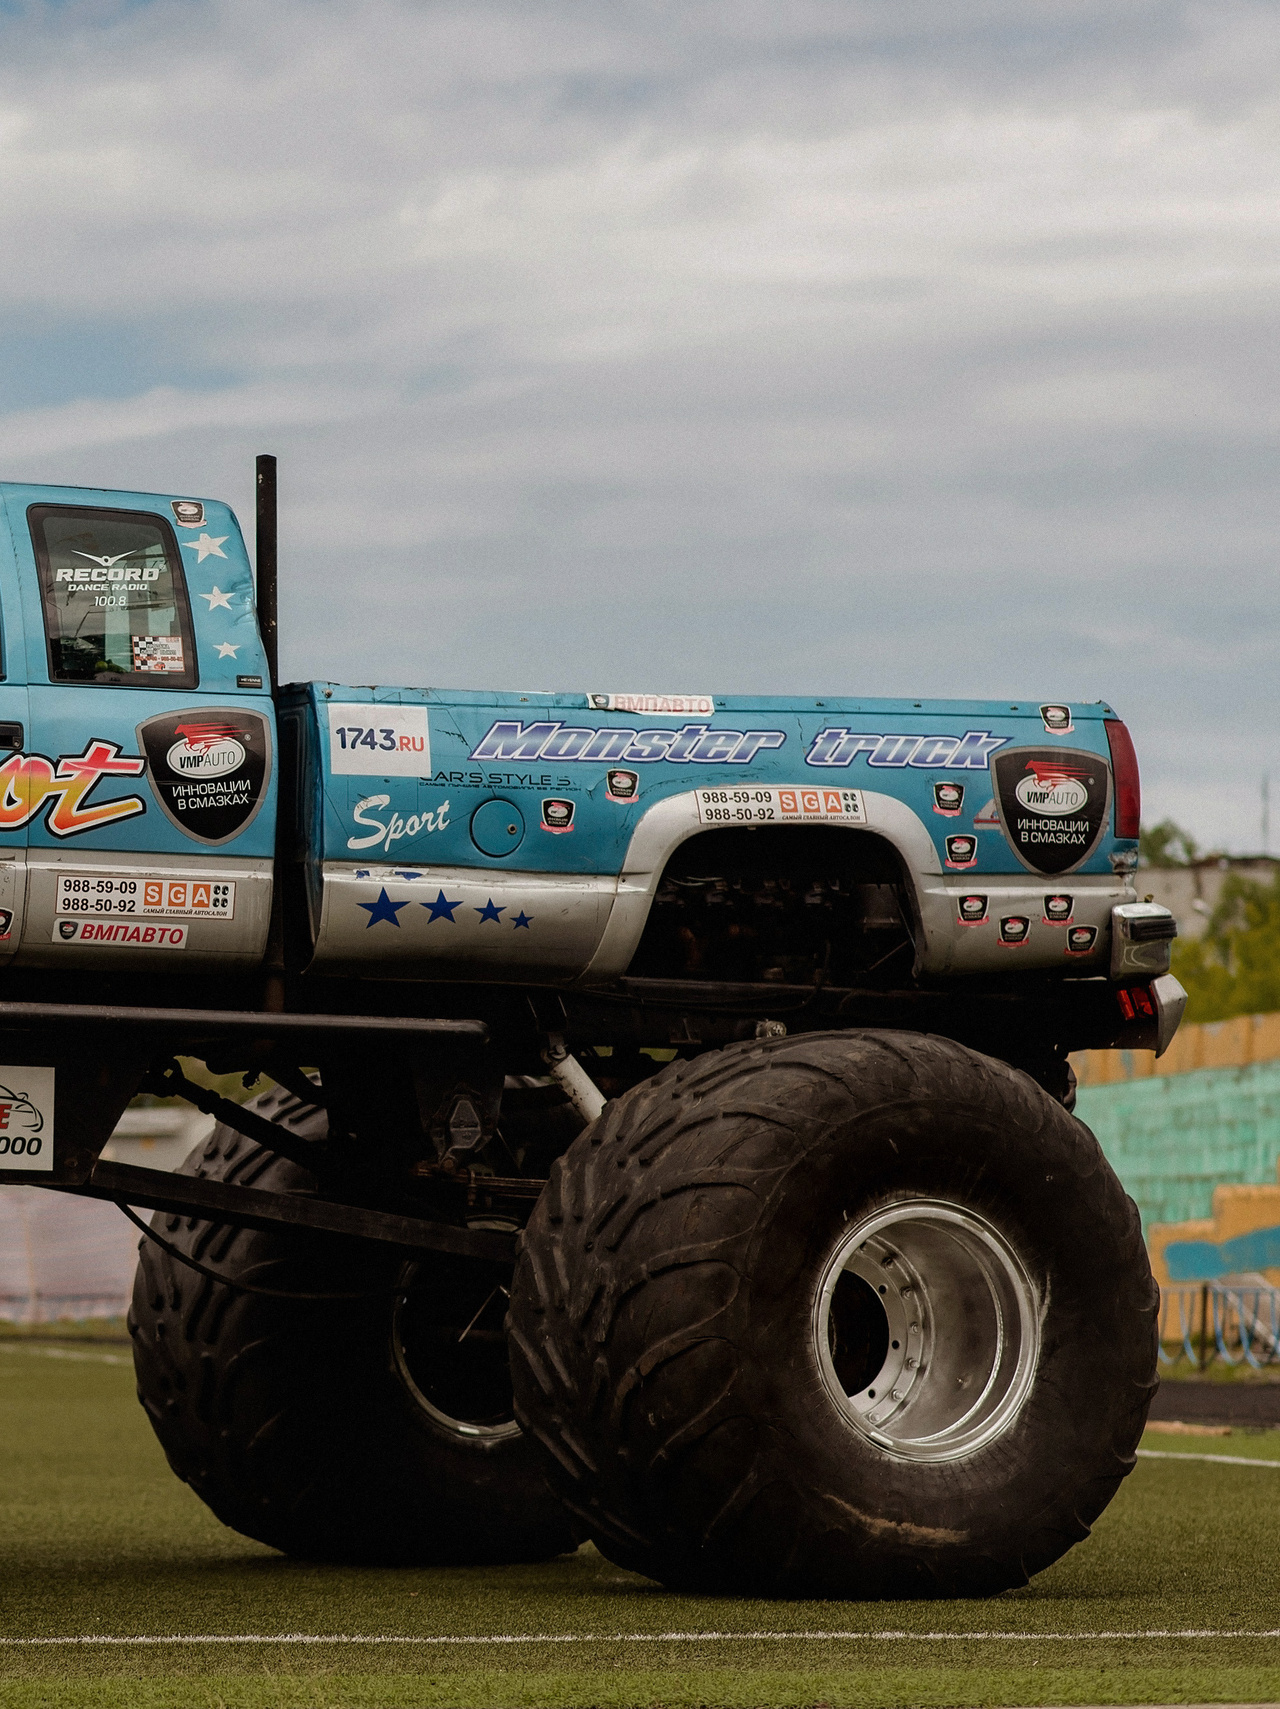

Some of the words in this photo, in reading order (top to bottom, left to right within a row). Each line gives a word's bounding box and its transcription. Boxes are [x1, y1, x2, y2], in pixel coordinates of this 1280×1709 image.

[55, 568, 160, 582] RECORD
[67, 583, 109, 592] DANCE
[111, 583, 148, 592] RADIO
[93, 595, 127, 607] 100.8
[336, 727, 425, 752] 1743.RU
[467, 720, 787, 764] Monster
[804, 727, 1015, 770] truck
[488, 773, 552, 786] STYLE
[172, 780, 251, 798] ИННОВАЦИИ
[177, 798, 187, 810] В
[188, 793, 250, 809] СМАЗКАХ
[702, 791, 772, 804] 988-59-09
[782, 793, 841, 811] SGA
[705, 808, 775, 821] 988-50-92
[347, 794, 451, 852] Sport
[1017, 818, 1089, 834] ИННОВАЦИИ
[1020, 831, 1029, 843] В
[1030, 832, 1086, 845] СМАЗКАХ
[63, 879, 137, 894] 988-59-09
[146, 885, 209, 905] SGA
[62, 897, 136, 913] 988-50-92
[79, 923, 184, 945] ВМПАВТО
